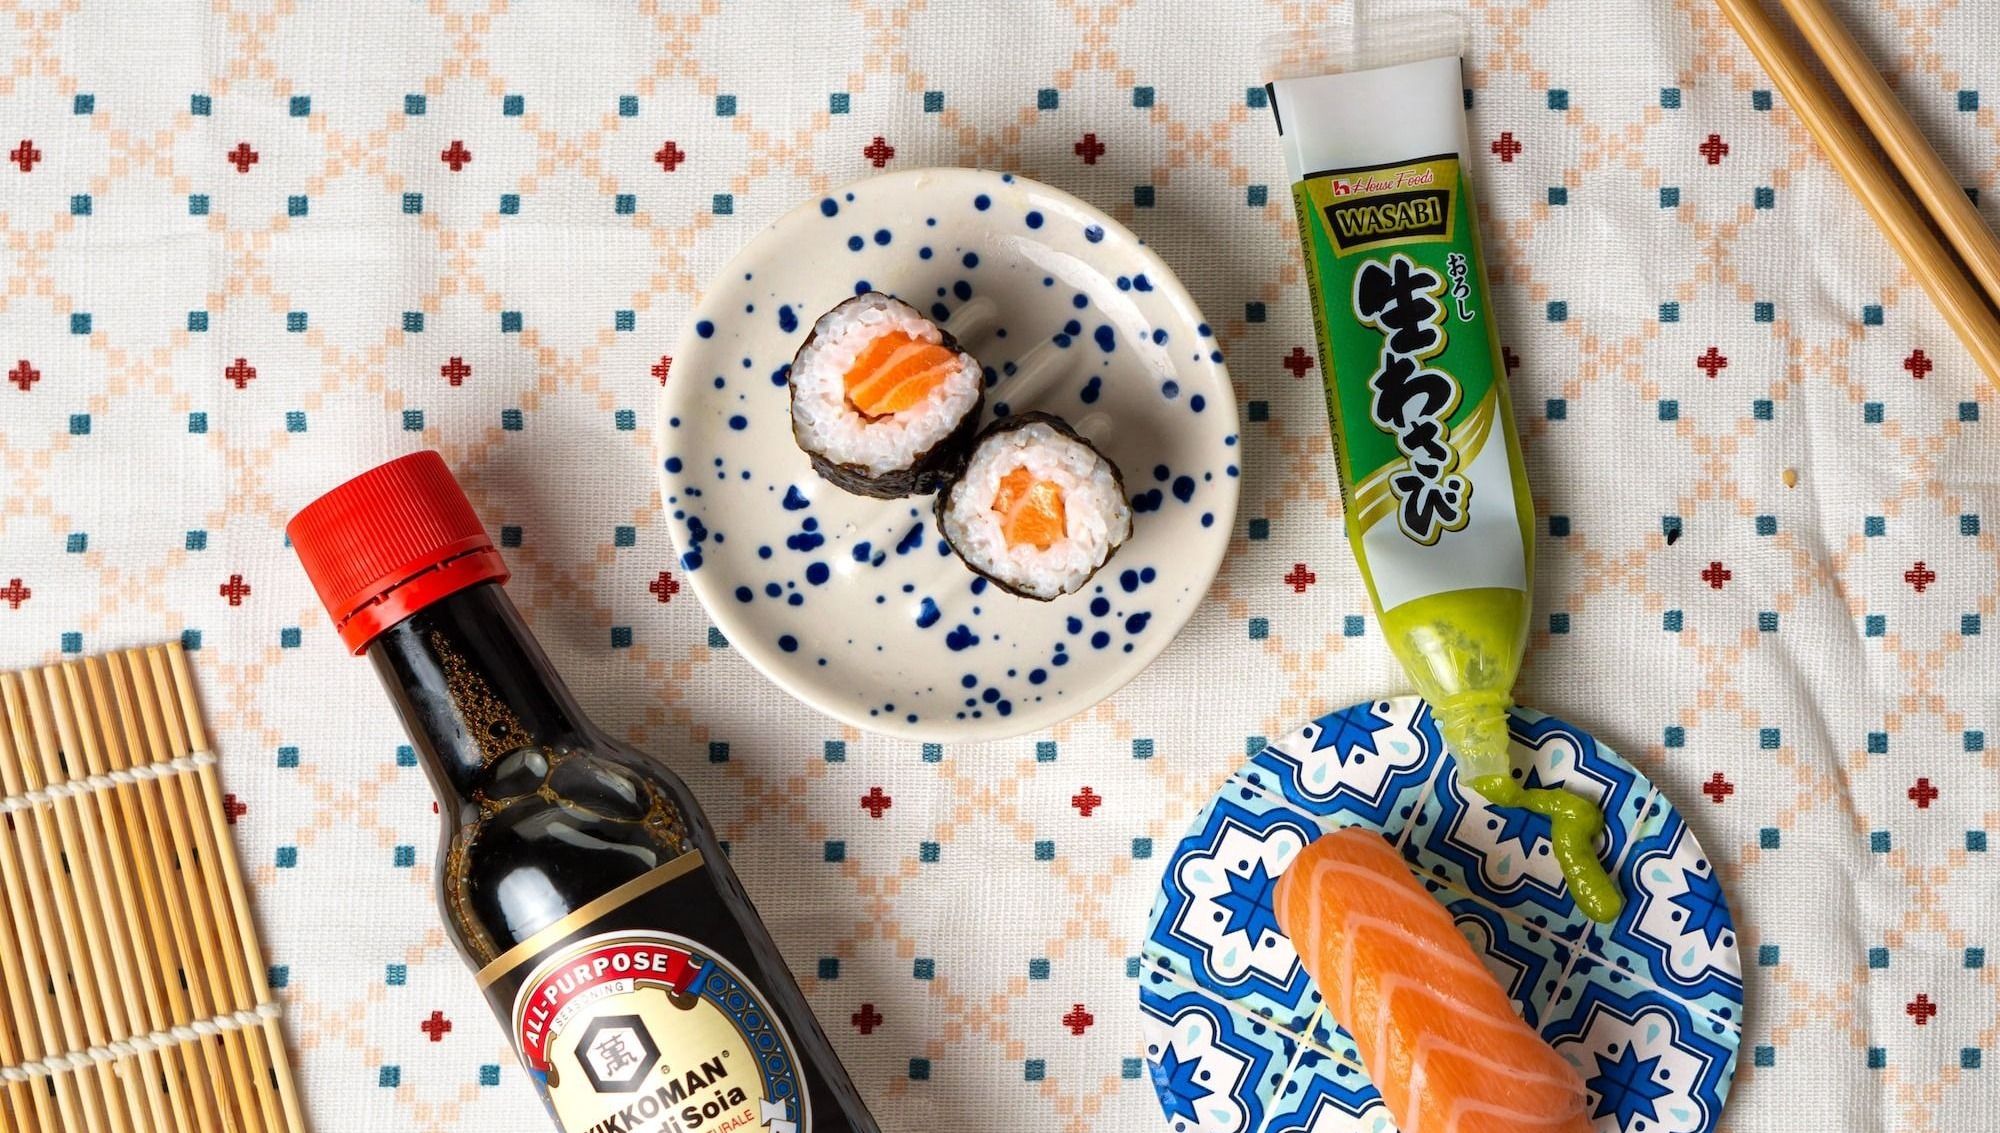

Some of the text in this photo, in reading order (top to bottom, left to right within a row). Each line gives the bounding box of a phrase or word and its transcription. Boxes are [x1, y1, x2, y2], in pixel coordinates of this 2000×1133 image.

[1352, 176, 1393, 194] House
[1395, 167, 1434, 189] Foods
[1336, 196, 1442, 237] WASABI
[1447, 253, 1474, 322] おろし
[1355, 254, 1464, 540] 生わさび
[524, 951, 669, 1048] ALL-PURPOSE
[556, 981, 625, 1028] SEASONING
[583, 1055, 729, 1133] KKOMAN
[681, 1085, 748, 1130] Soia
